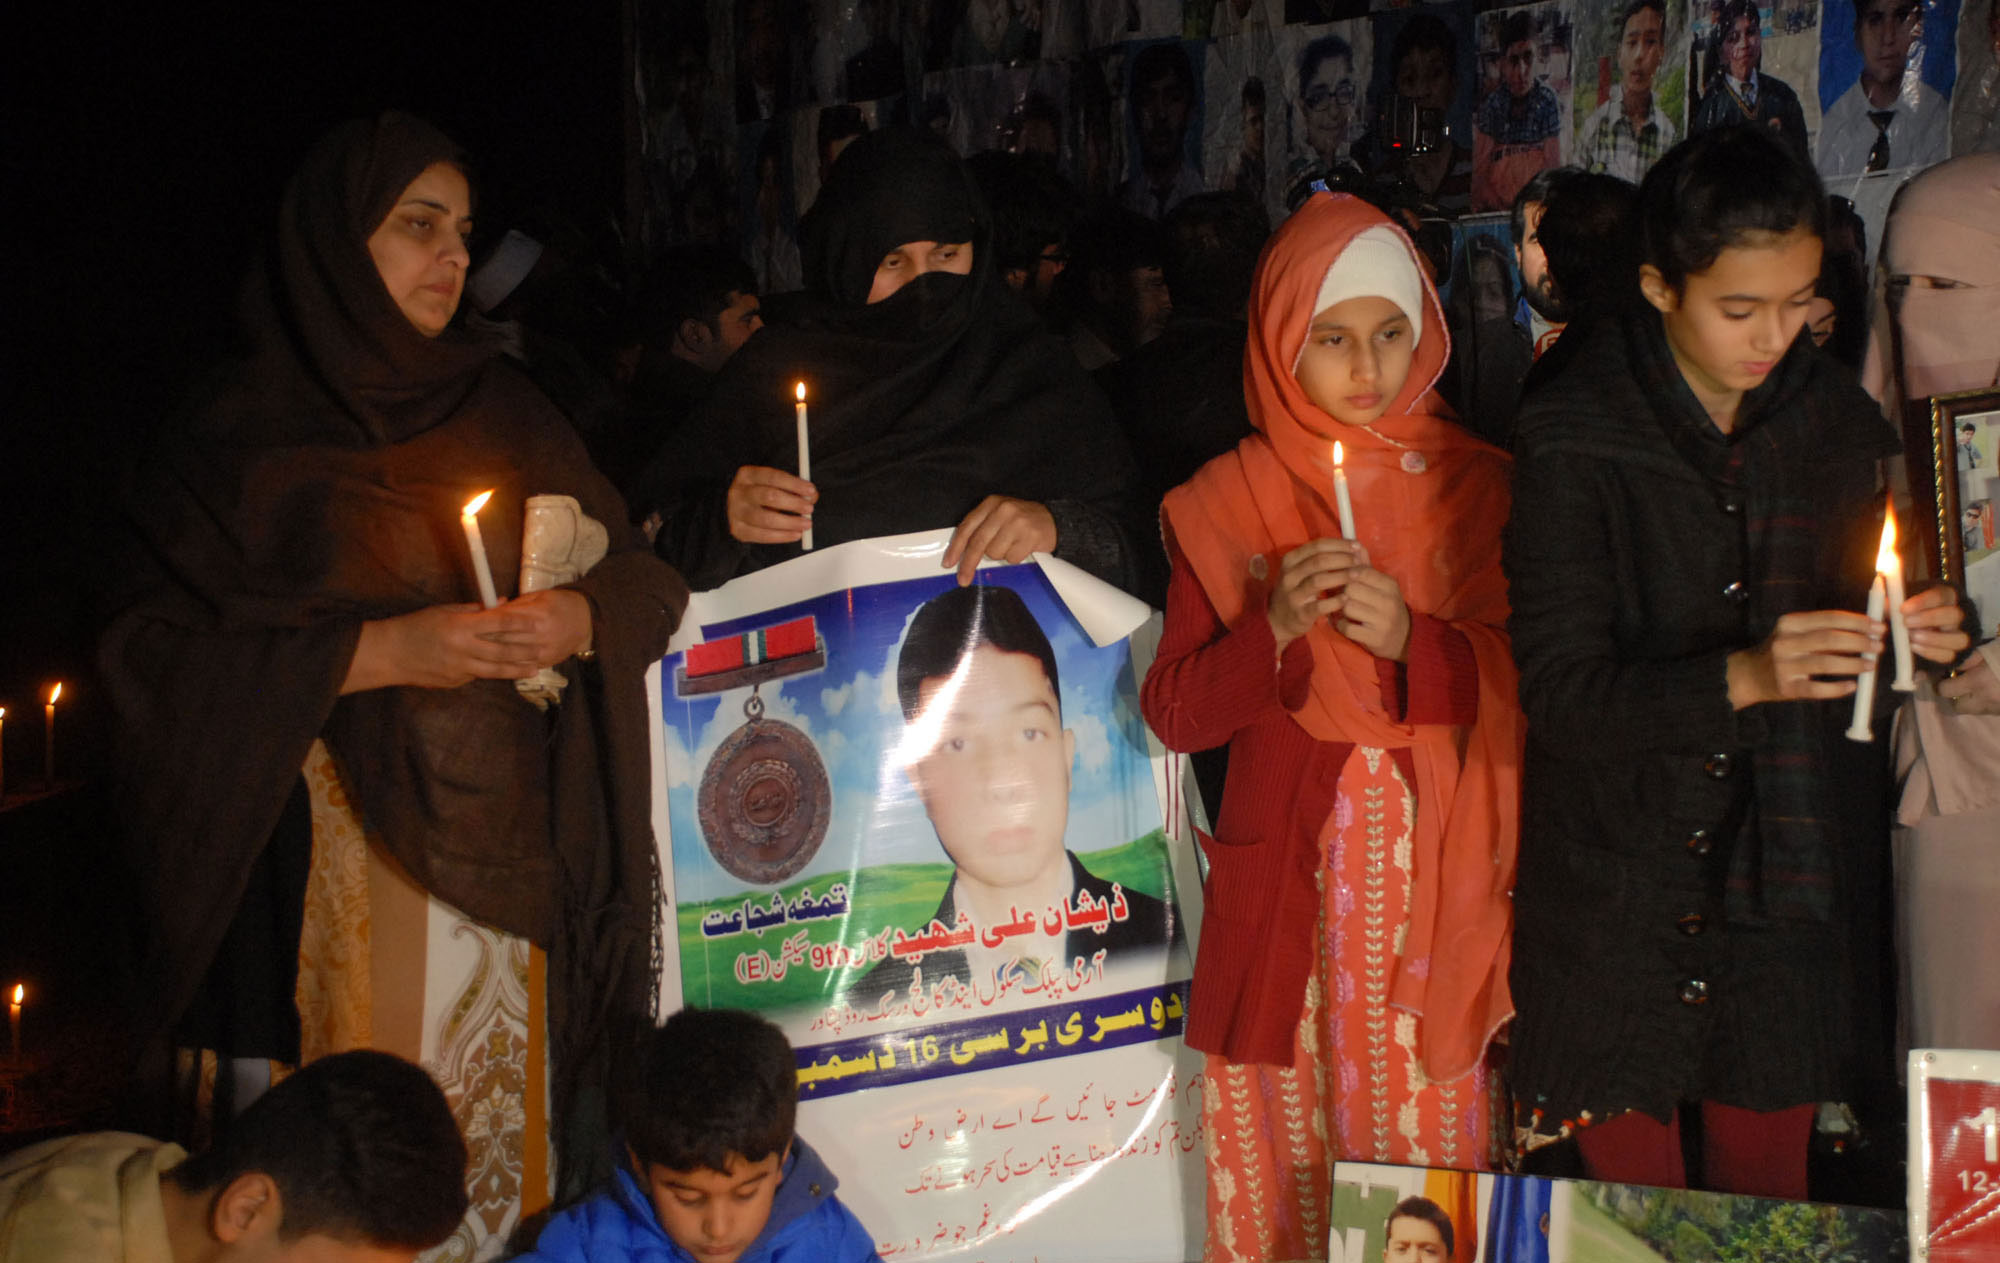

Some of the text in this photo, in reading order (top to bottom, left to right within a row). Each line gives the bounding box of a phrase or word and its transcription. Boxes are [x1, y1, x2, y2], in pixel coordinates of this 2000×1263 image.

[703, 893, 786, 936] شجاعت
[981, 905, 1036, 948] علی
[1042, 883, 1129, 937] ذیشان
[811, 943, 849, 969] 9th
[891, 911, 976, 963] شہید
[911, 967, 950, 1016] کالج
[980, 956, 1024, 1005] سکول
[1022, 957, 1064, 998] پبلک
[1066, 950, 1106, 991] آرمی
[951, 975, 976, 1009] اینڈ
[796, 992, 1183, 1090] دوسری برسی 16 دسمب
[810, 1007, 842, 1035] پشاور
[993, 1108, 1022, 1129] اے
[1031, 1094, 1056, 1123] گے
